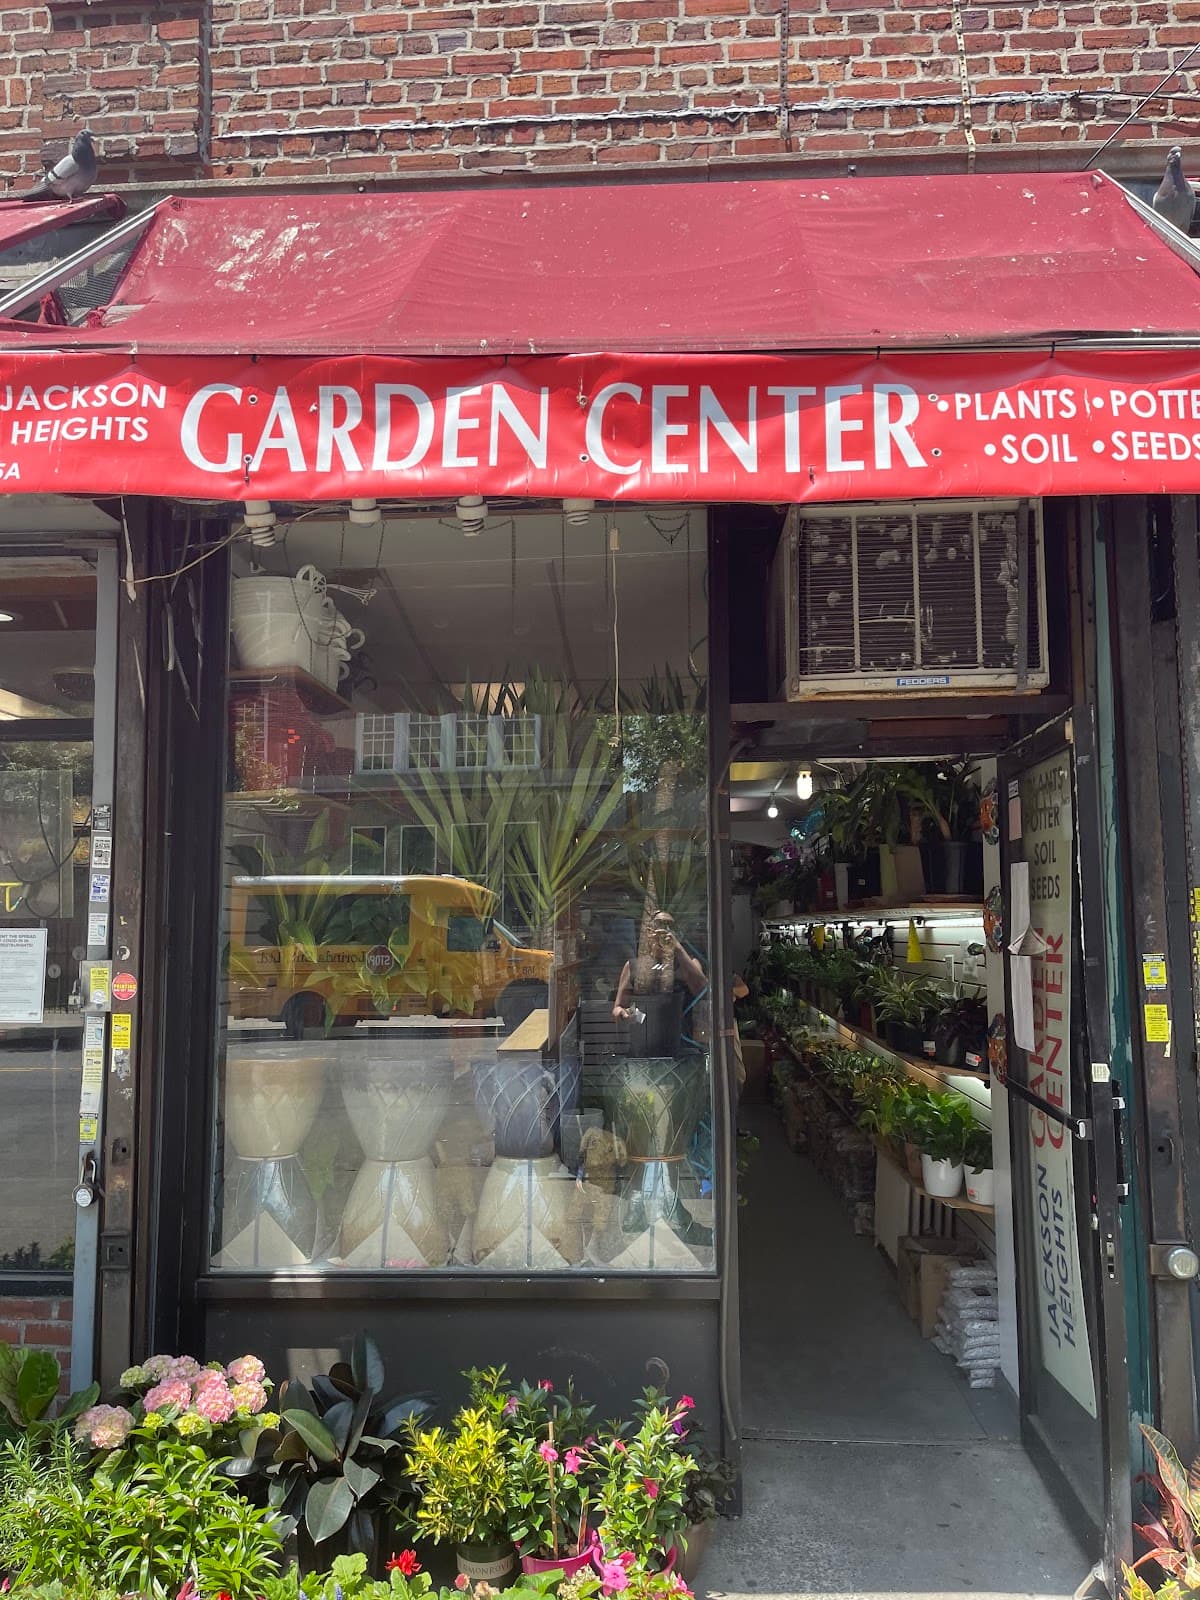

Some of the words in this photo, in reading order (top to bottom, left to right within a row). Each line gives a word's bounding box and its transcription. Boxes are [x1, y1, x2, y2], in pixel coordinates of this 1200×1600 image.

[0, 383, 166, 411] JACKSON
[955, 389, 1077, 420] PLANTS
[11, 416, 149, 444] HEIGHTS
[181, 383, 549, 472] GARDEN
[585, 382, 928, 475] CENTER
[1001, 433, 1078, 464] SOIL
[1034, 840, 1057, 866] SOIL
[1030, 874, 1060, 900] SEEDS
[1036, 1164, 1061, 1348] JACKSON
[1050, 1188, 1076, 1347] HEIGHTS
